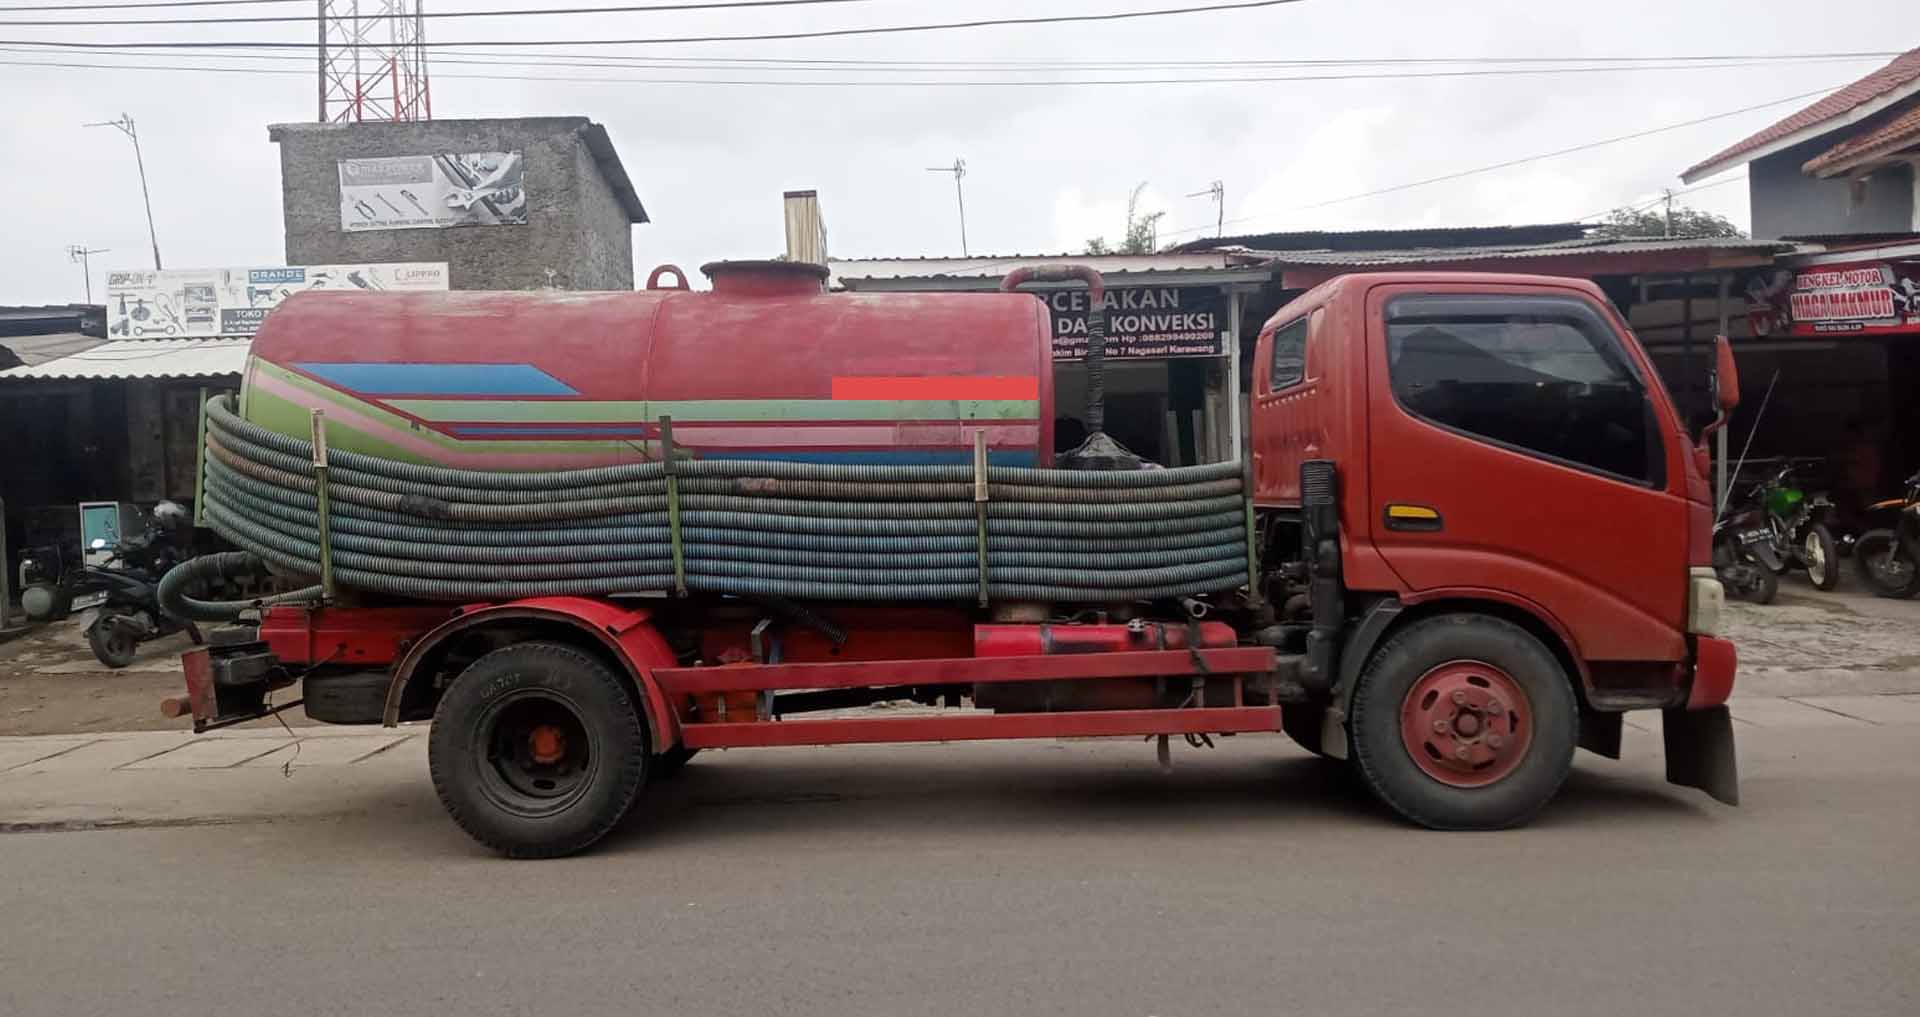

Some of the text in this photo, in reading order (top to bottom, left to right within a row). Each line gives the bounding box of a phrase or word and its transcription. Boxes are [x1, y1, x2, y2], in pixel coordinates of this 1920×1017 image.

[1844, 269, 1881, 285] MOTOR
[1791, 289, 1893, 319] NIAGA MAKMUR
[236, 310, 262, 318] TOKO
[1111, 313, 1215, 334] KONVEKSI
[1128, 344, 1168, 356] Nagasari
[1169, 344, 1215, 354] Karawang
